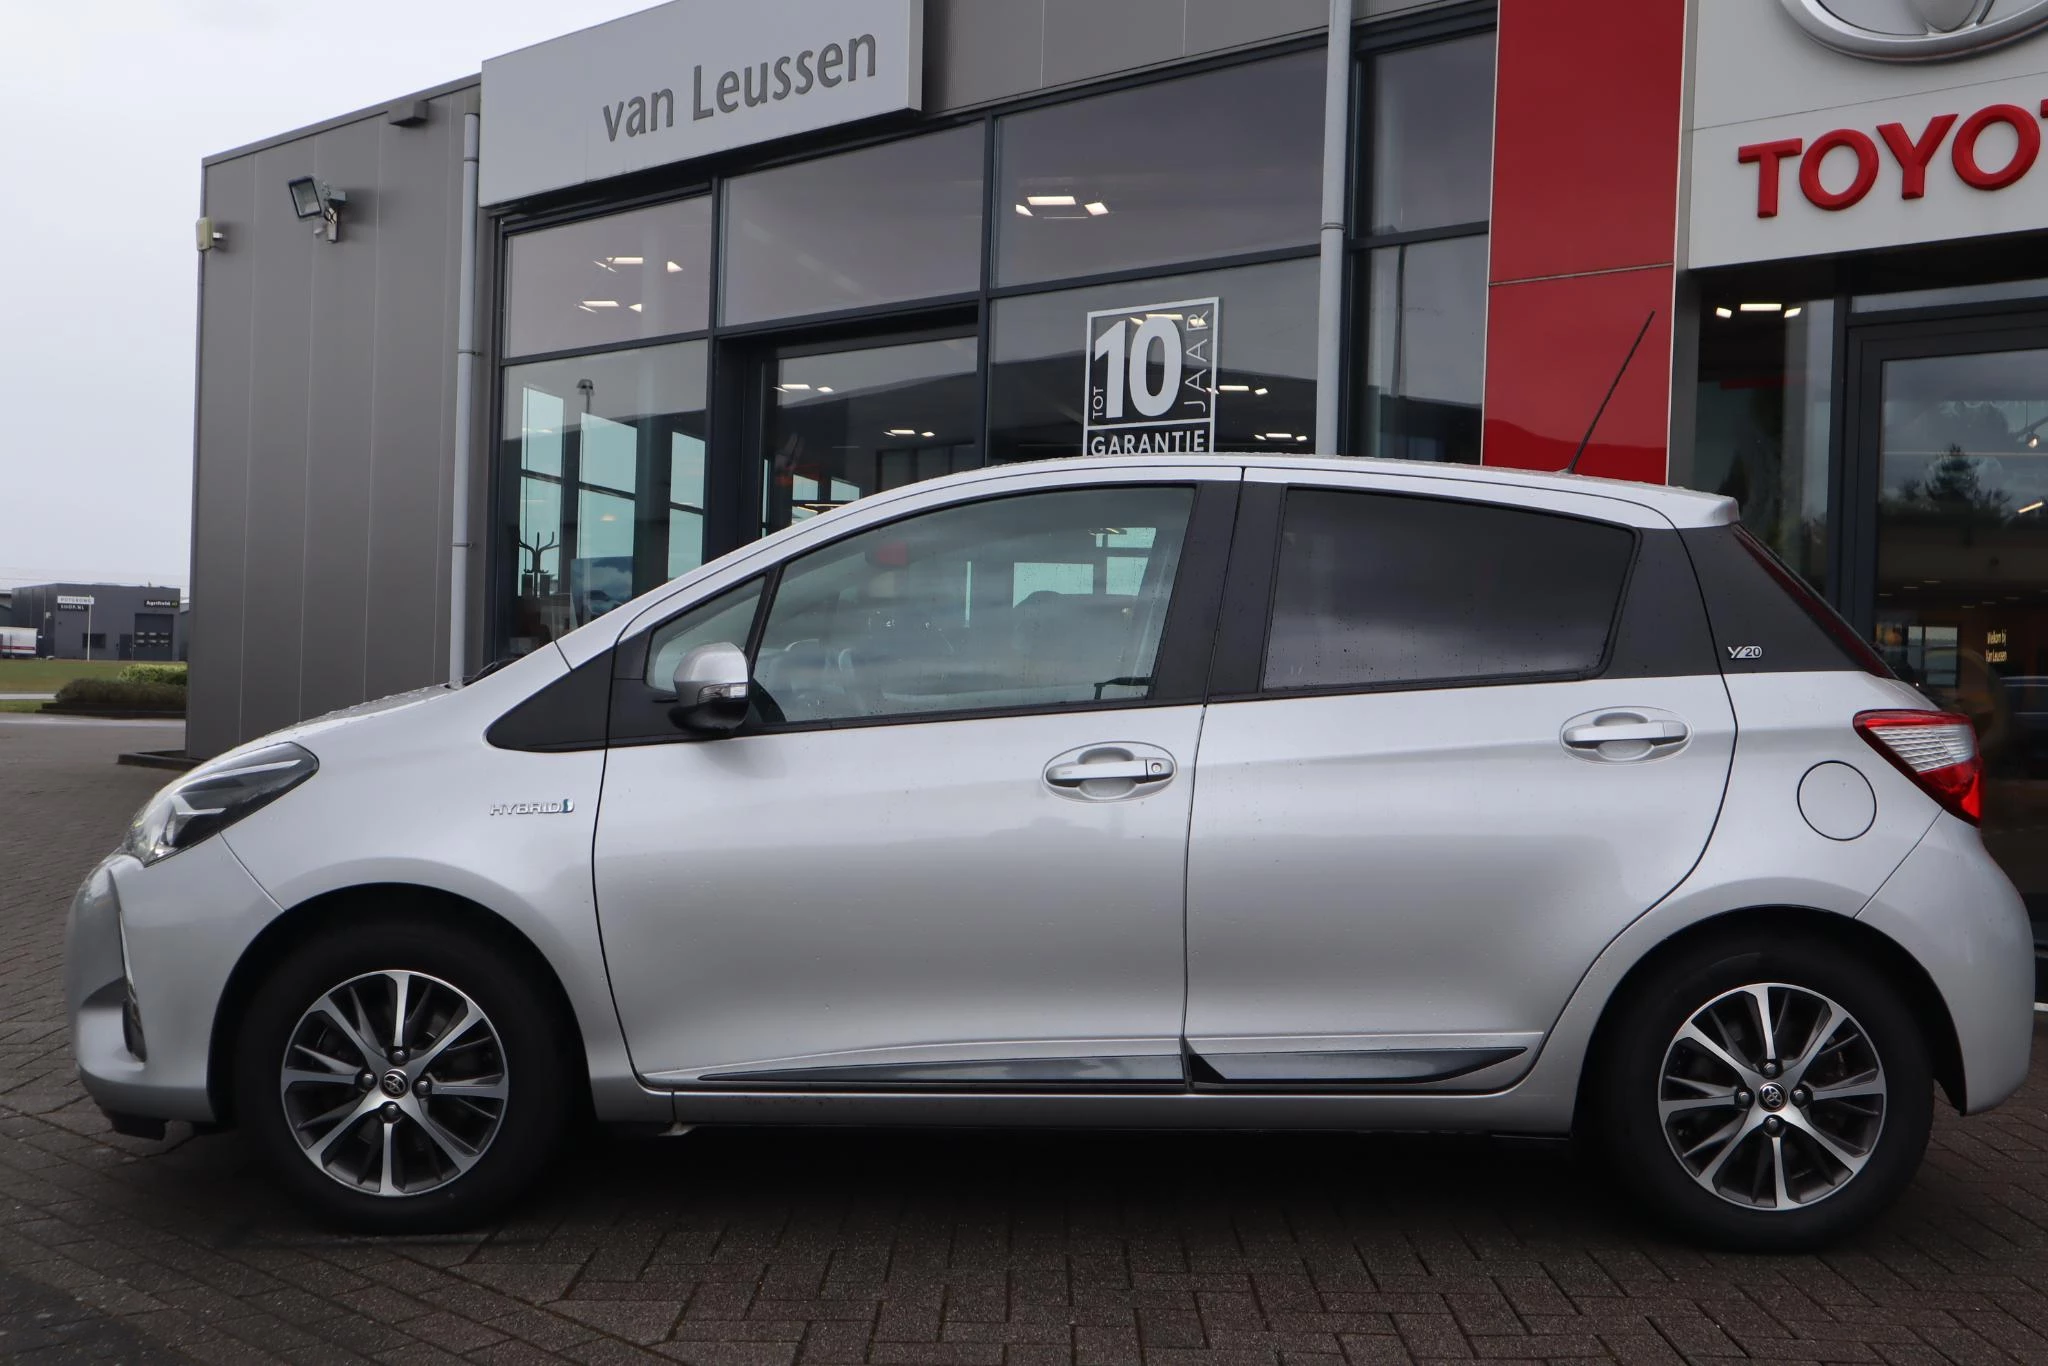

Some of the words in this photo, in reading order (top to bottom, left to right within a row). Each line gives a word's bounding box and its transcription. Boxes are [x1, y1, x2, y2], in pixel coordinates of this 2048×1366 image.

[602, 87, 674, 142] van
[692, 33, 877, 121] Leussen
[1738, 98, 2048, 219] TOYO
[1092, 385, 1104, 420] TOT
[1094, 316, 1182, 419] 10
[1184, 310, 1209, 413] JAAR
[1091, 430, 1205, 456] GARANTIE
[490, 801, 561, 816] HYBRID
